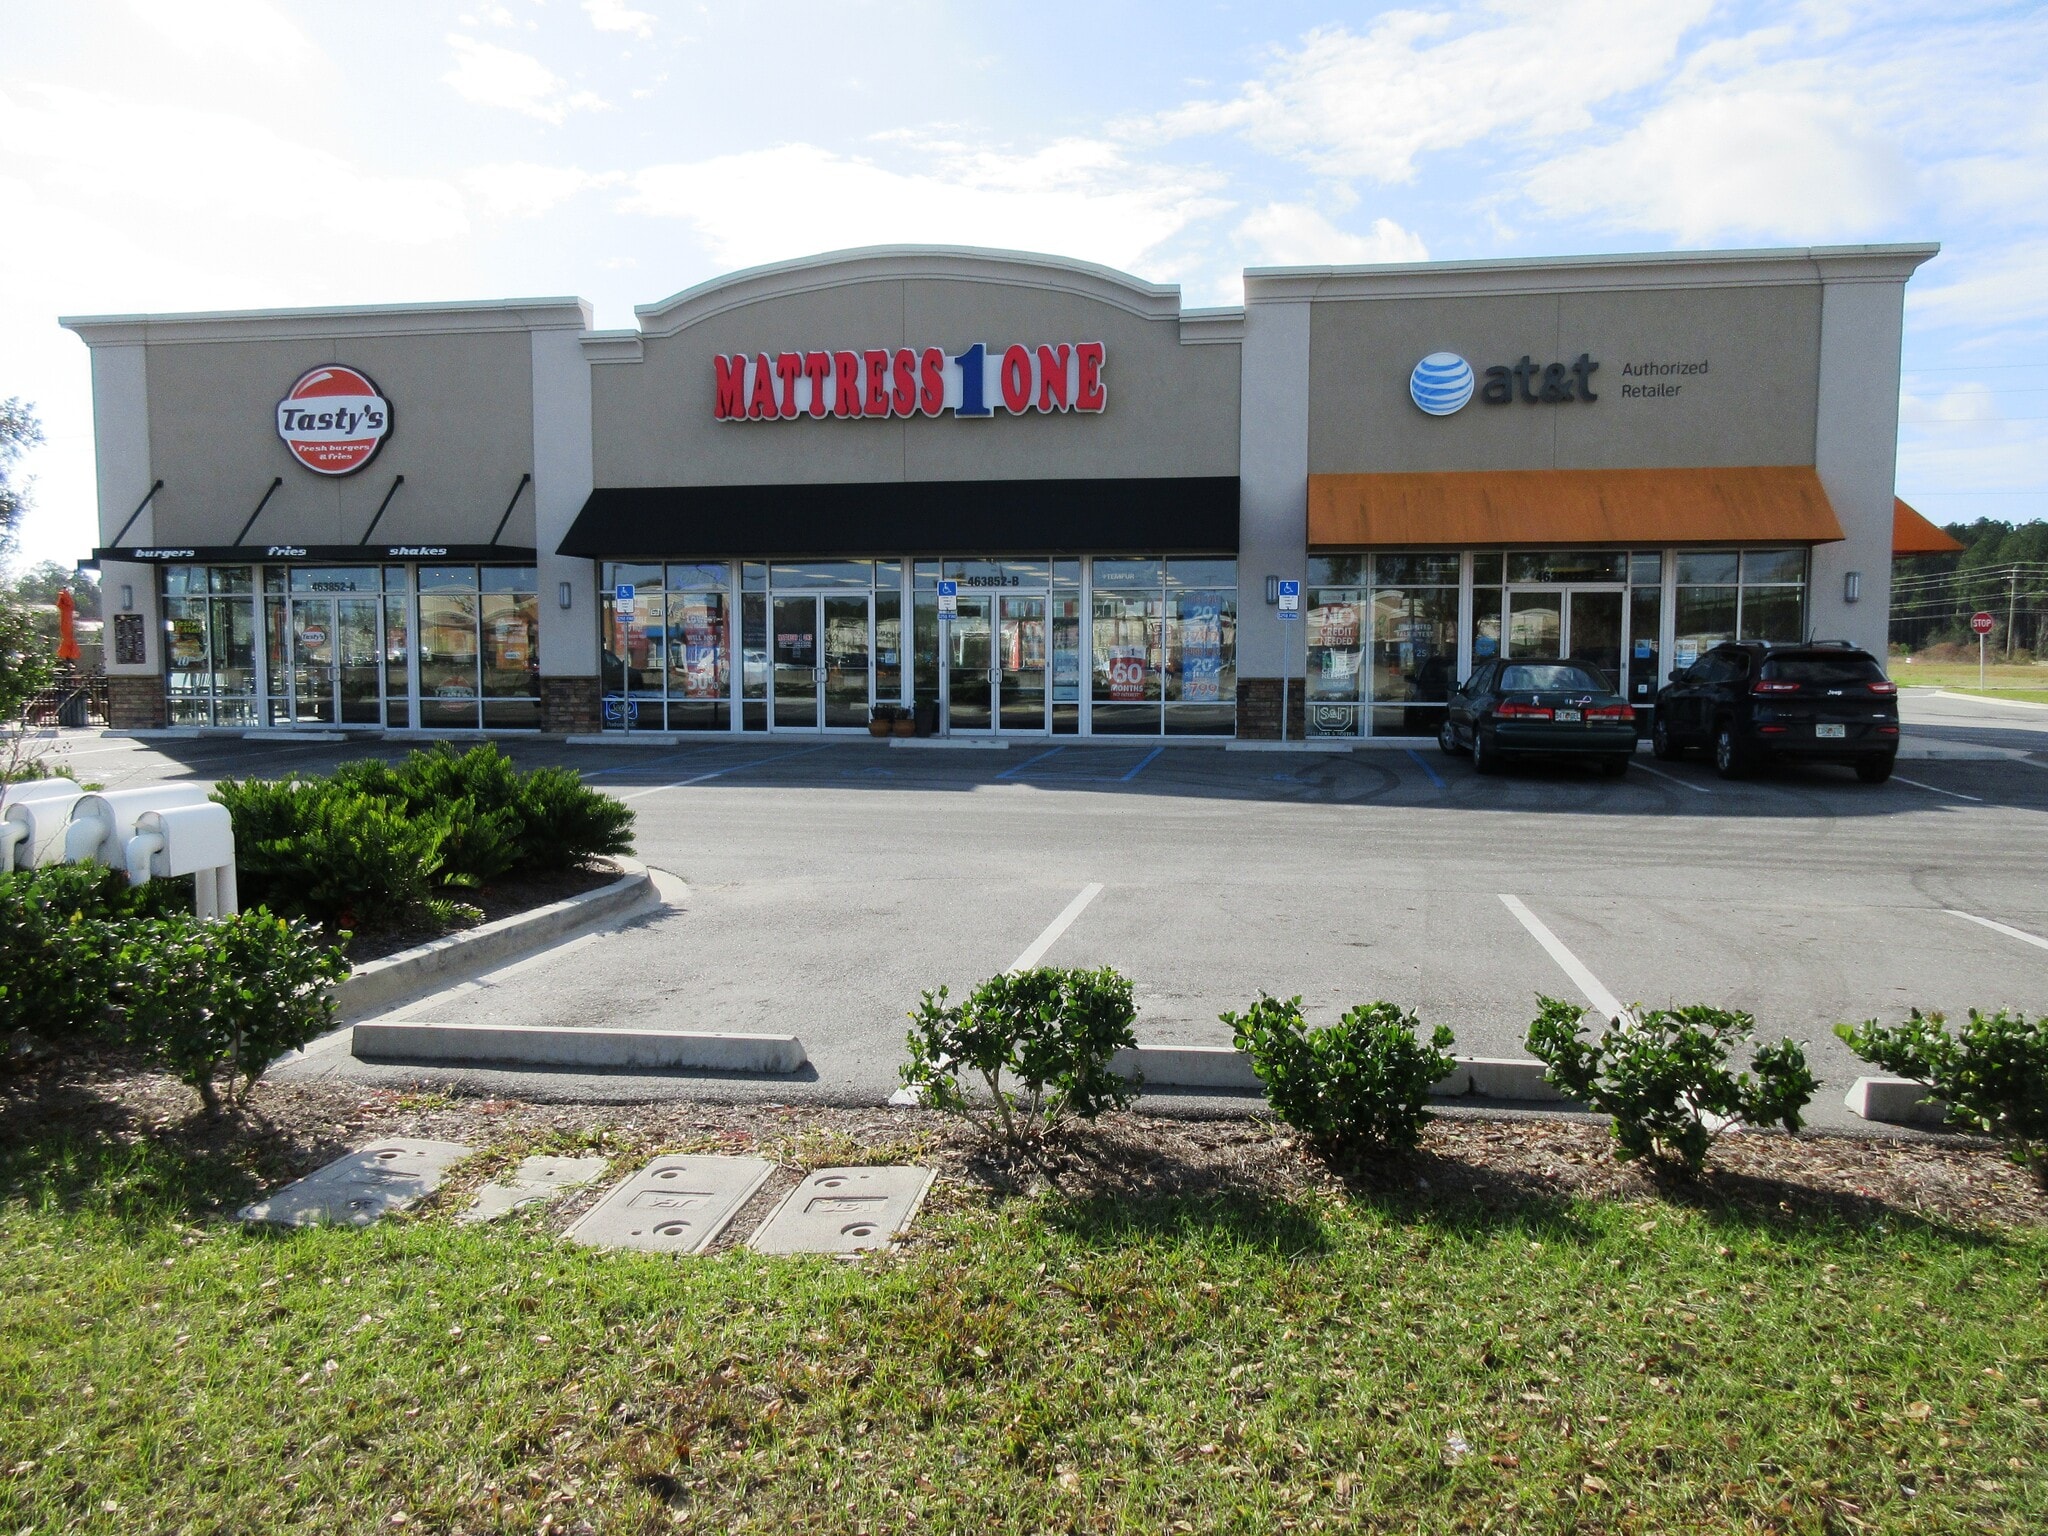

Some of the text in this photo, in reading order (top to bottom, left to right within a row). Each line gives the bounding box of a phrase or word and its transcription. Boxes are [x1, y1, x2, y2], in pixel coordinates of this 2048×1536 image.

[1622, 360, 1708, 376] Authorized
[714, 342, 1104, 420] MATTRESS 1 ONE
[1481, 353, 1599, 405] at&t
[1622, 384, 1682, 398] Retailer
[283, 404, 384, 435] Tasty's
[298, 444, 370, 454] fresh burgers
[327, 452, 353, 460] fries
[135, 548, 195, 559] burgers
[267, 546, 307, 557] fries
[389, 546, 447, 557] shakes
[312, 582, 356, 592] 463852-A
[967, 576, 1020, 587] 463852-B
[1973, 618, 1992, 628] STOP
[1321, 626, 1353, 637] CREDIT
[1321, 637, 1353, 645] NEEDED
[1112, 663, 1143, 684] 60
[1111, 684, 1144, 692] MONTHS
[1319, 706, 1347, 720] S&F
